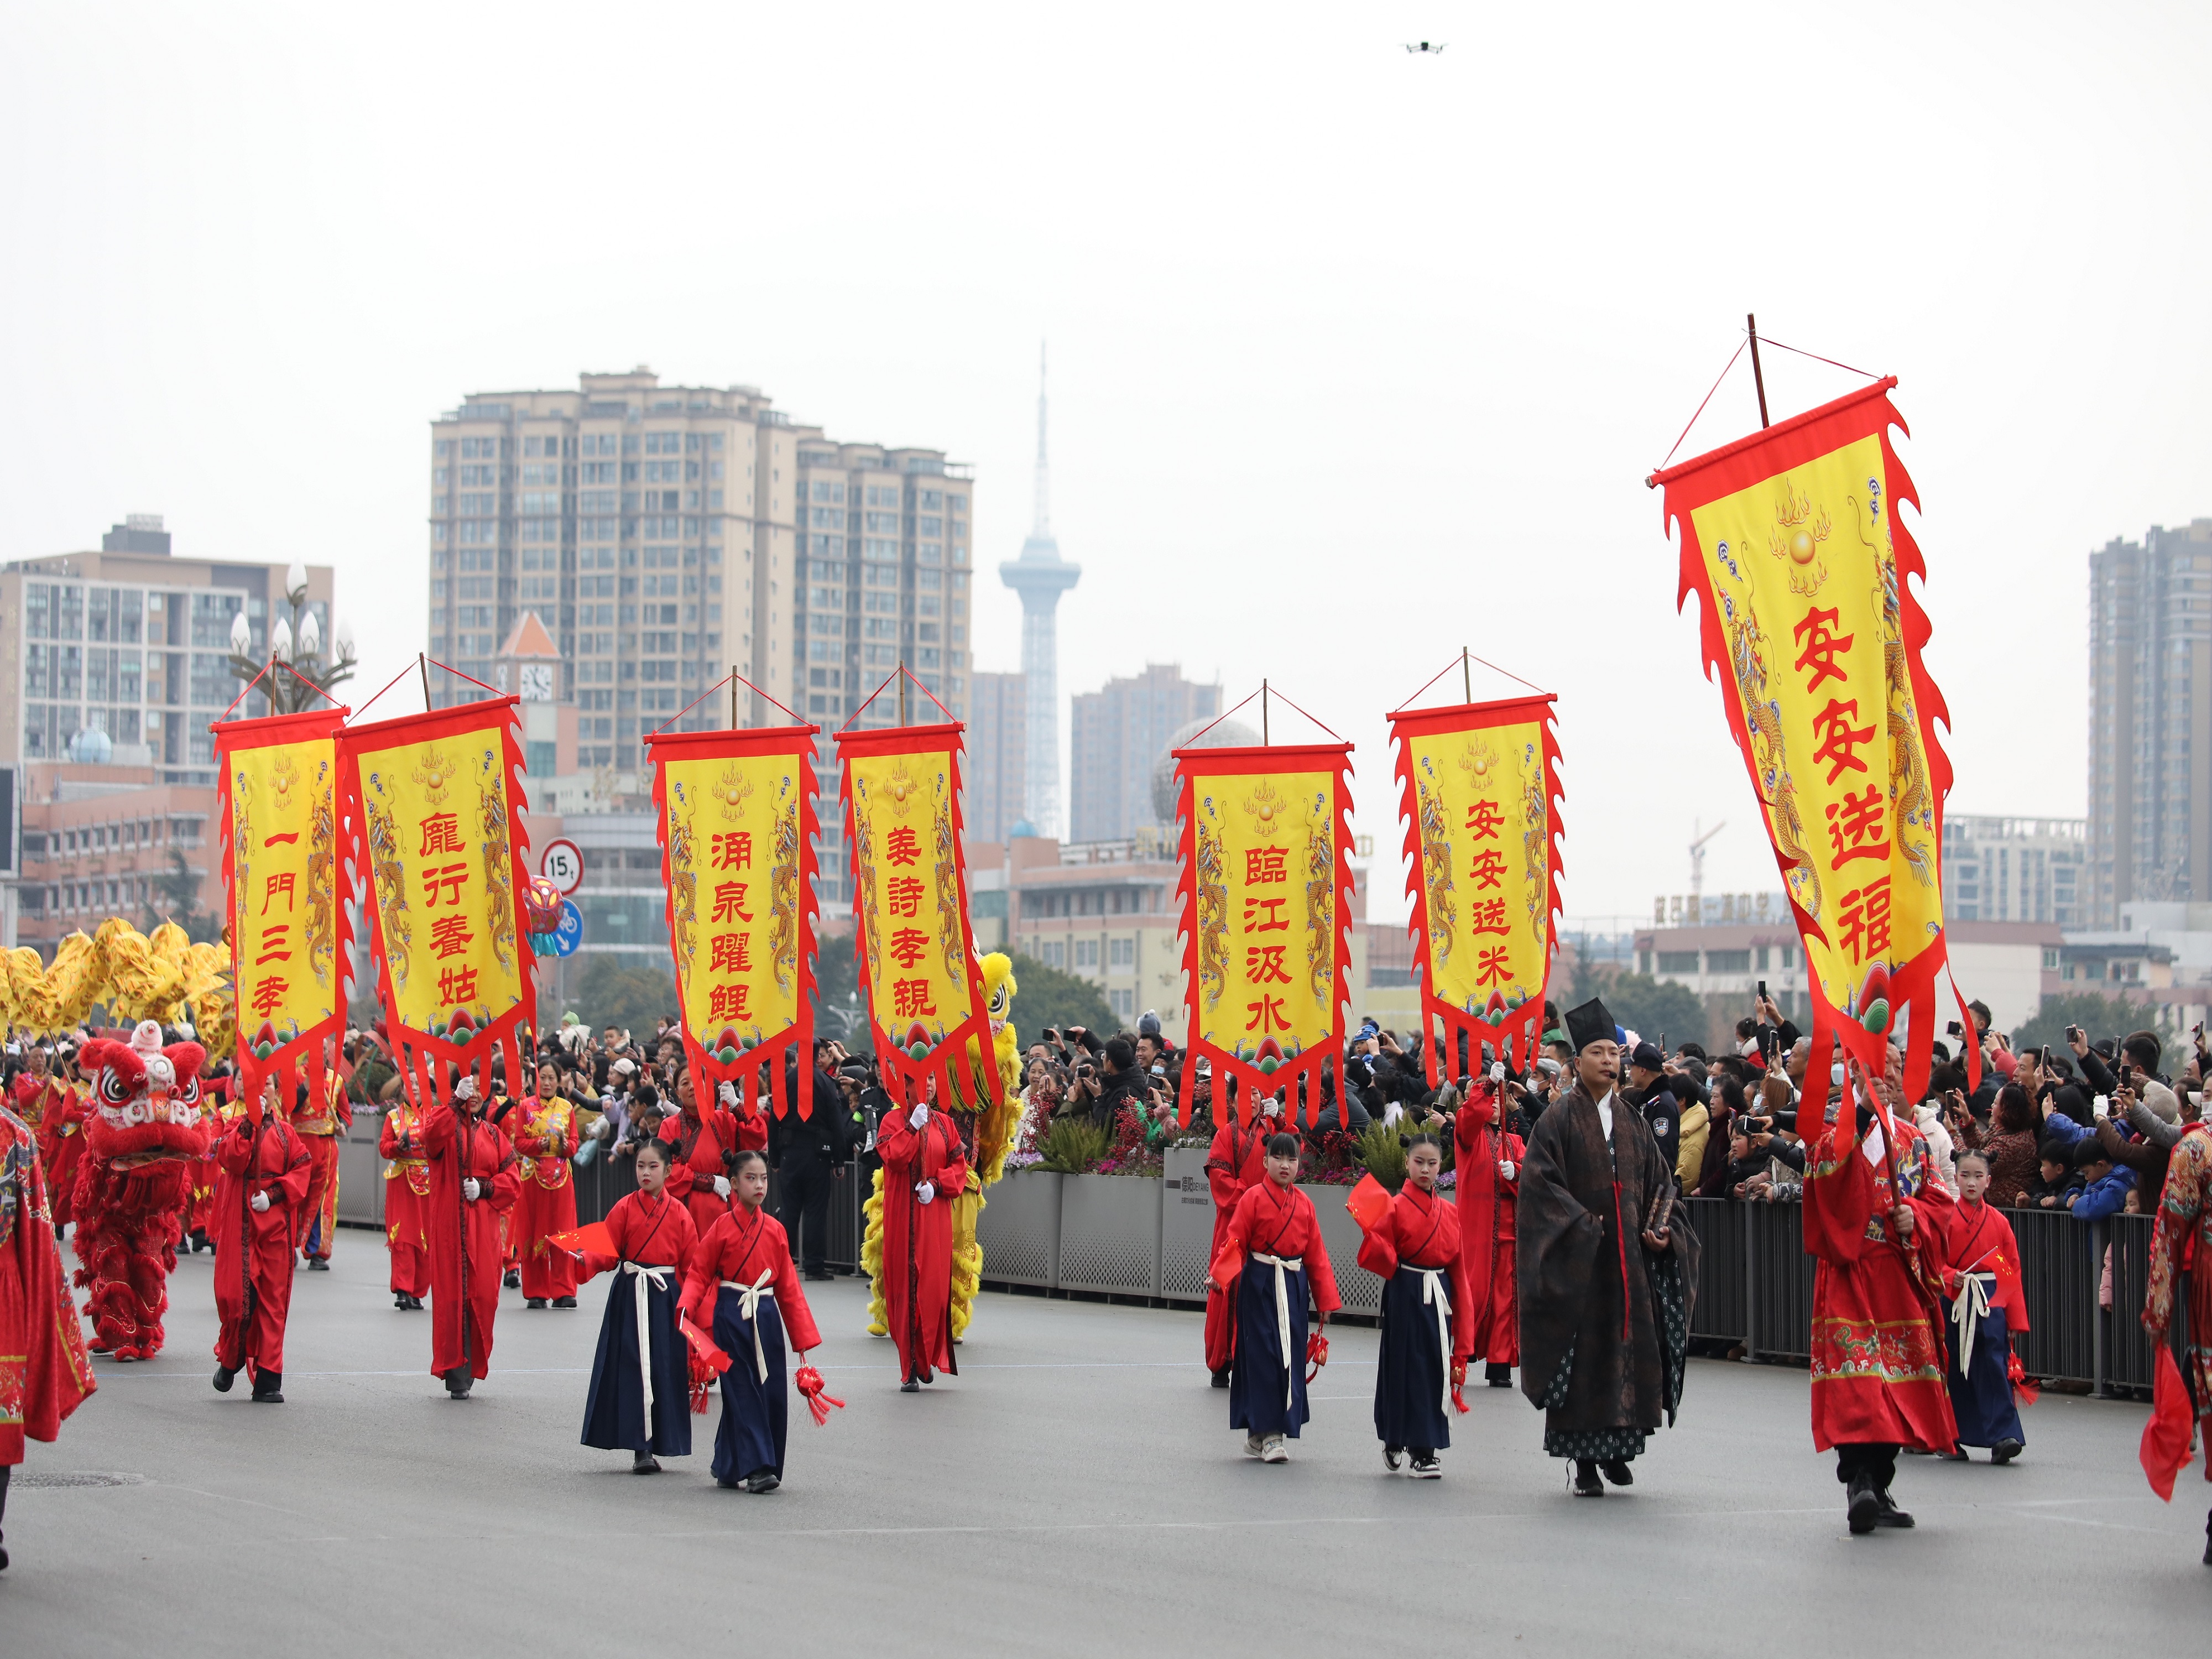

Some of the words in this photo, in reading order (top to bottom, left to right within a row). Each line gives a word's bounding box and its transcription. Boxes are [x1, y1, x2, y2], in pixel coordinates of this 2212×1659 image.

[1793, 607, 1891, 966] 安安送福
[252, 832, 299, 1018] 一門三孝
[419, 812, 478, 1008] 龐行養姑
[708, 831, 754, 1024] 涌泉躍鯉
[886, 825, 937, 1018] 姜詩孝親
[1244, 844, 1293, 1034] 臨江汲水
[1465, 799, 1514, 988] 安安送米
